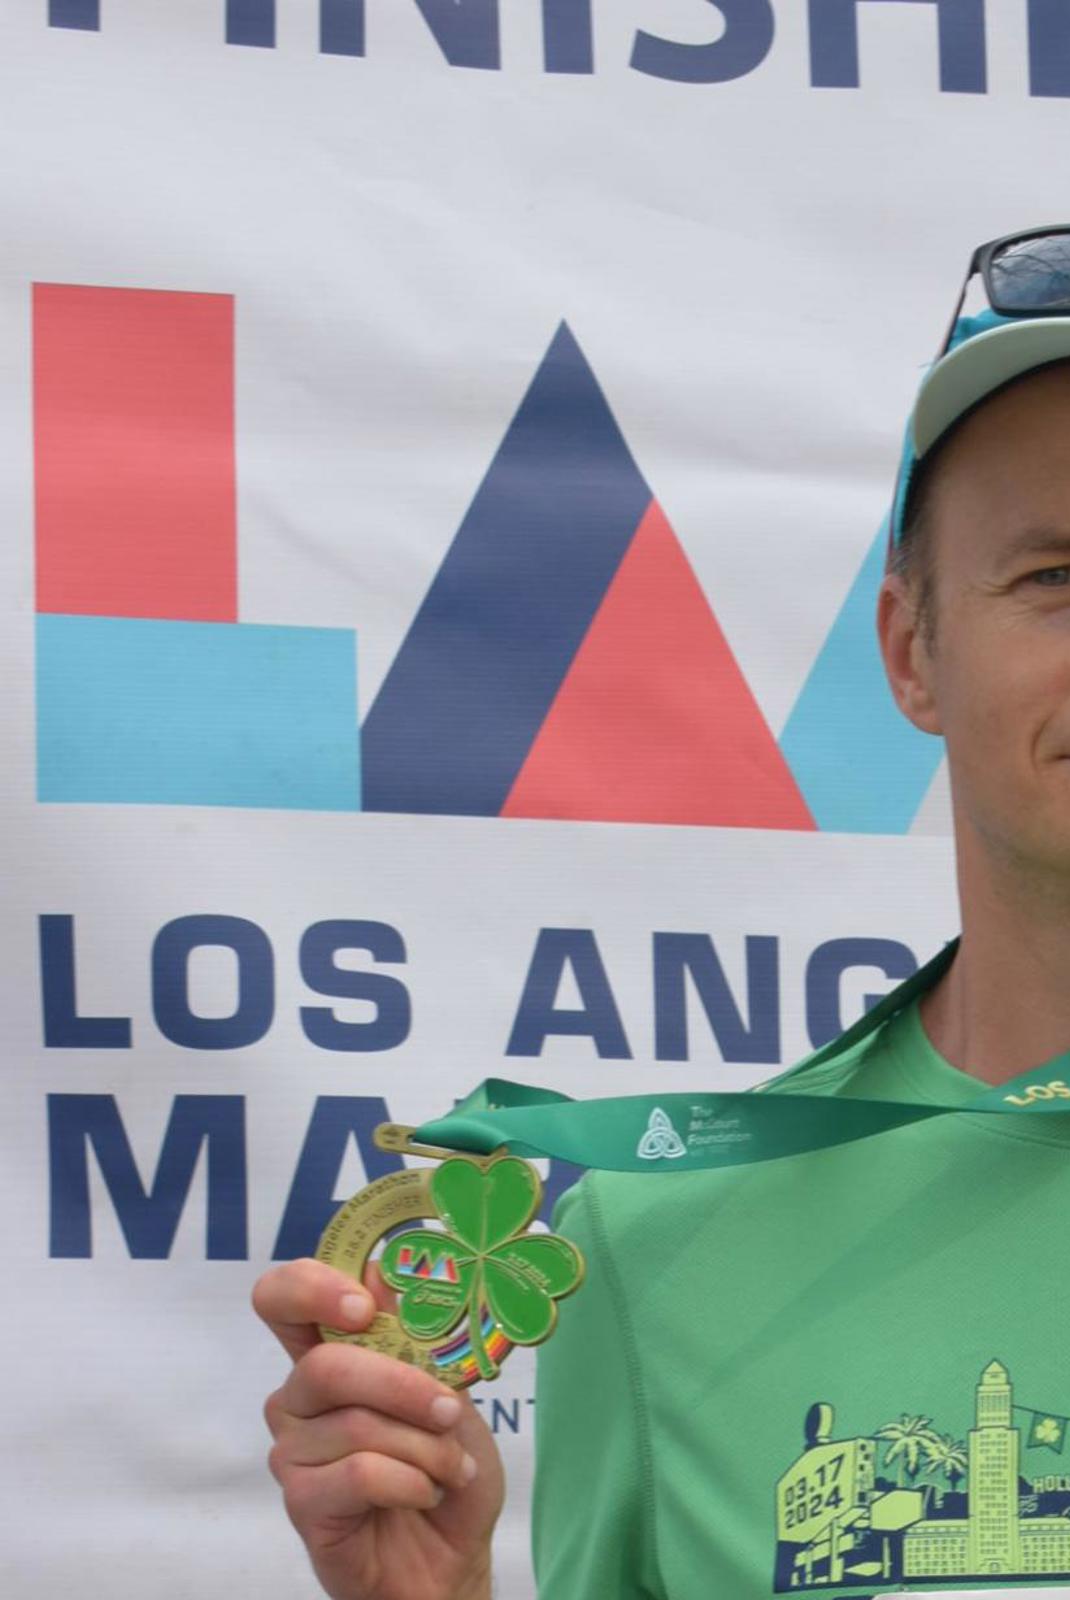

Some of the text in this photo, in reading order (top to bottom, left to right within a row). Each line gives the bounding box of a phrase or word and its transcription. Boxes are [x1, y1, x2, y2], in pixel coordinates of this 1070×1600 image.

[38, 914, 412, 1053] LOS
[785, 1453, 844, 1507] 03.17
[786, 1485, 843, 1529] 2024
